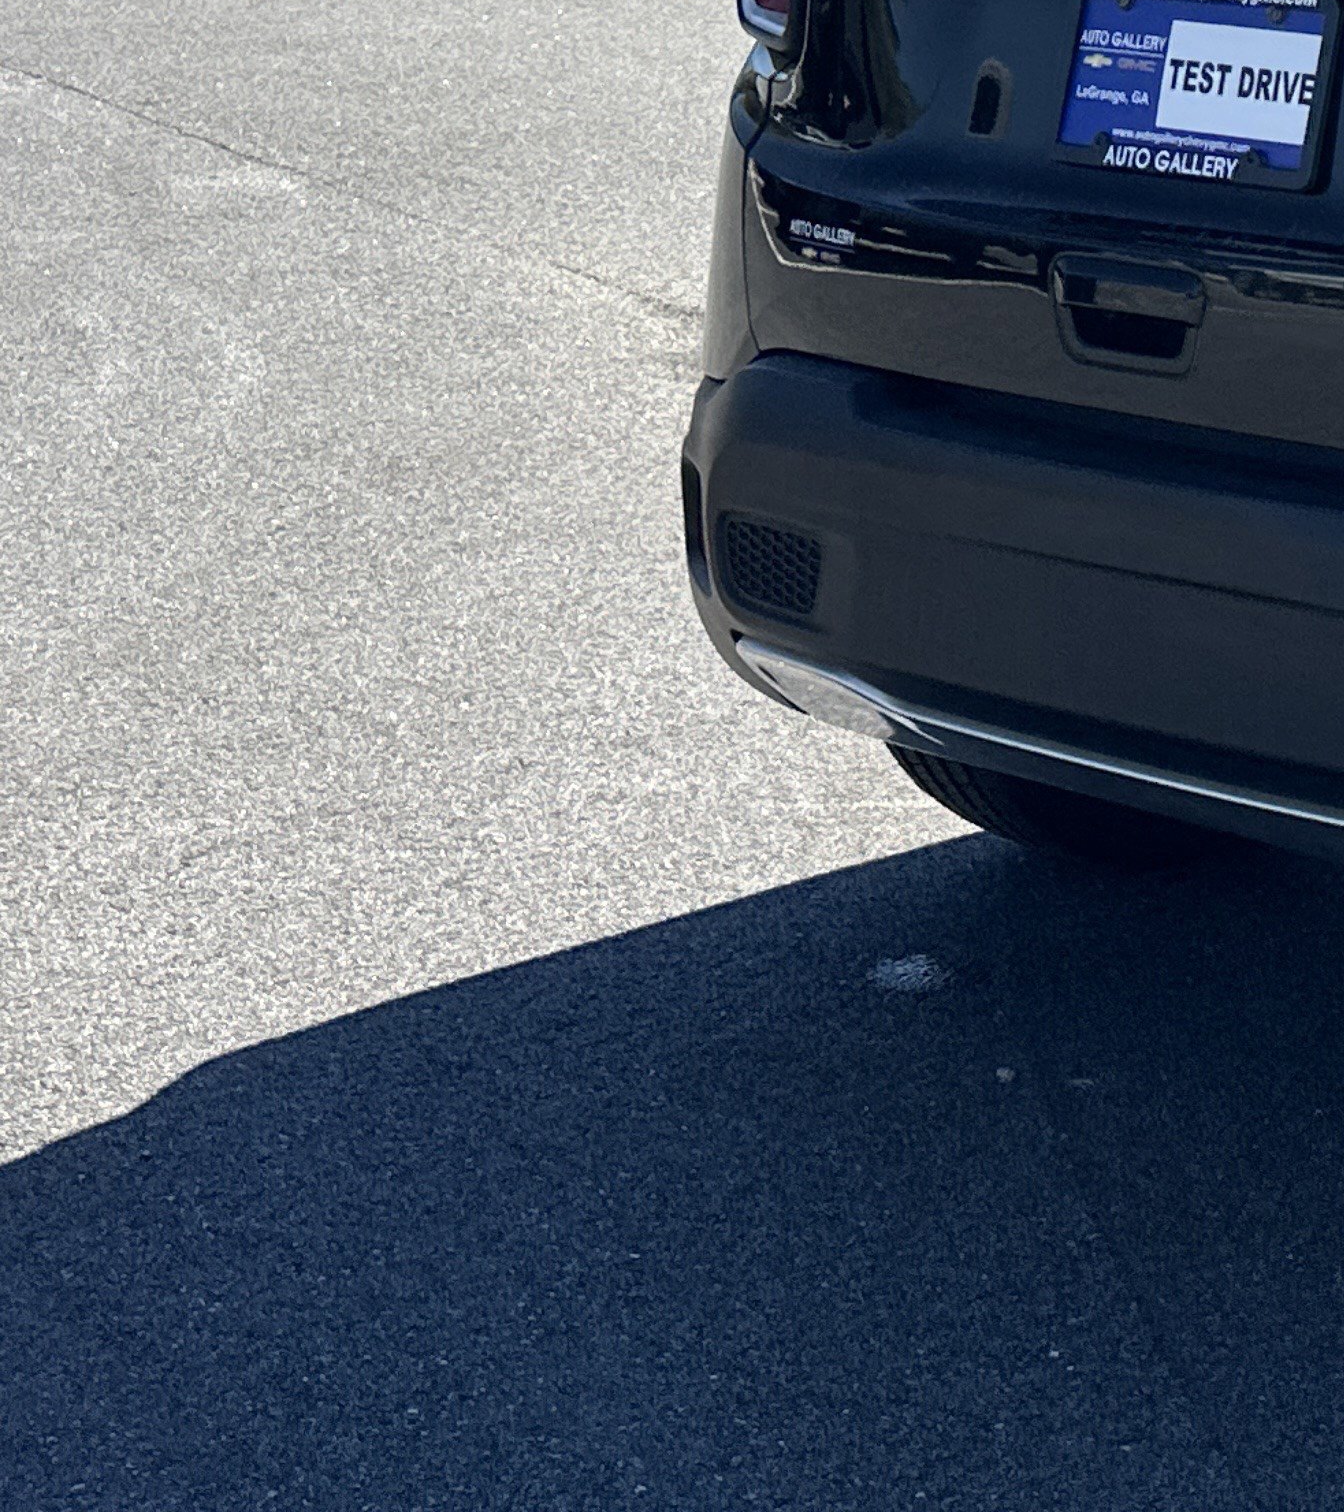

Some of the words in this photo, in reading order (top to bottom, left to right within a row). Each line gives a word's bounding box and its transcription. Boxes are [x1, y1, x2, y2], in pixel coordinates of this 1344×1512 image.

[1080, 29, 1110, 46] AUTO
[1112, 31, 1167, 52] GALLERY
[1169, 58, 1232, 96] TEST
[1237, 65, 1317, 107] DRIVE
[1131, 90, 1150, 106] GA
[1103, 144, 1150, 170] AUTO
[1154, 149, 1239, 181] GALLERY
